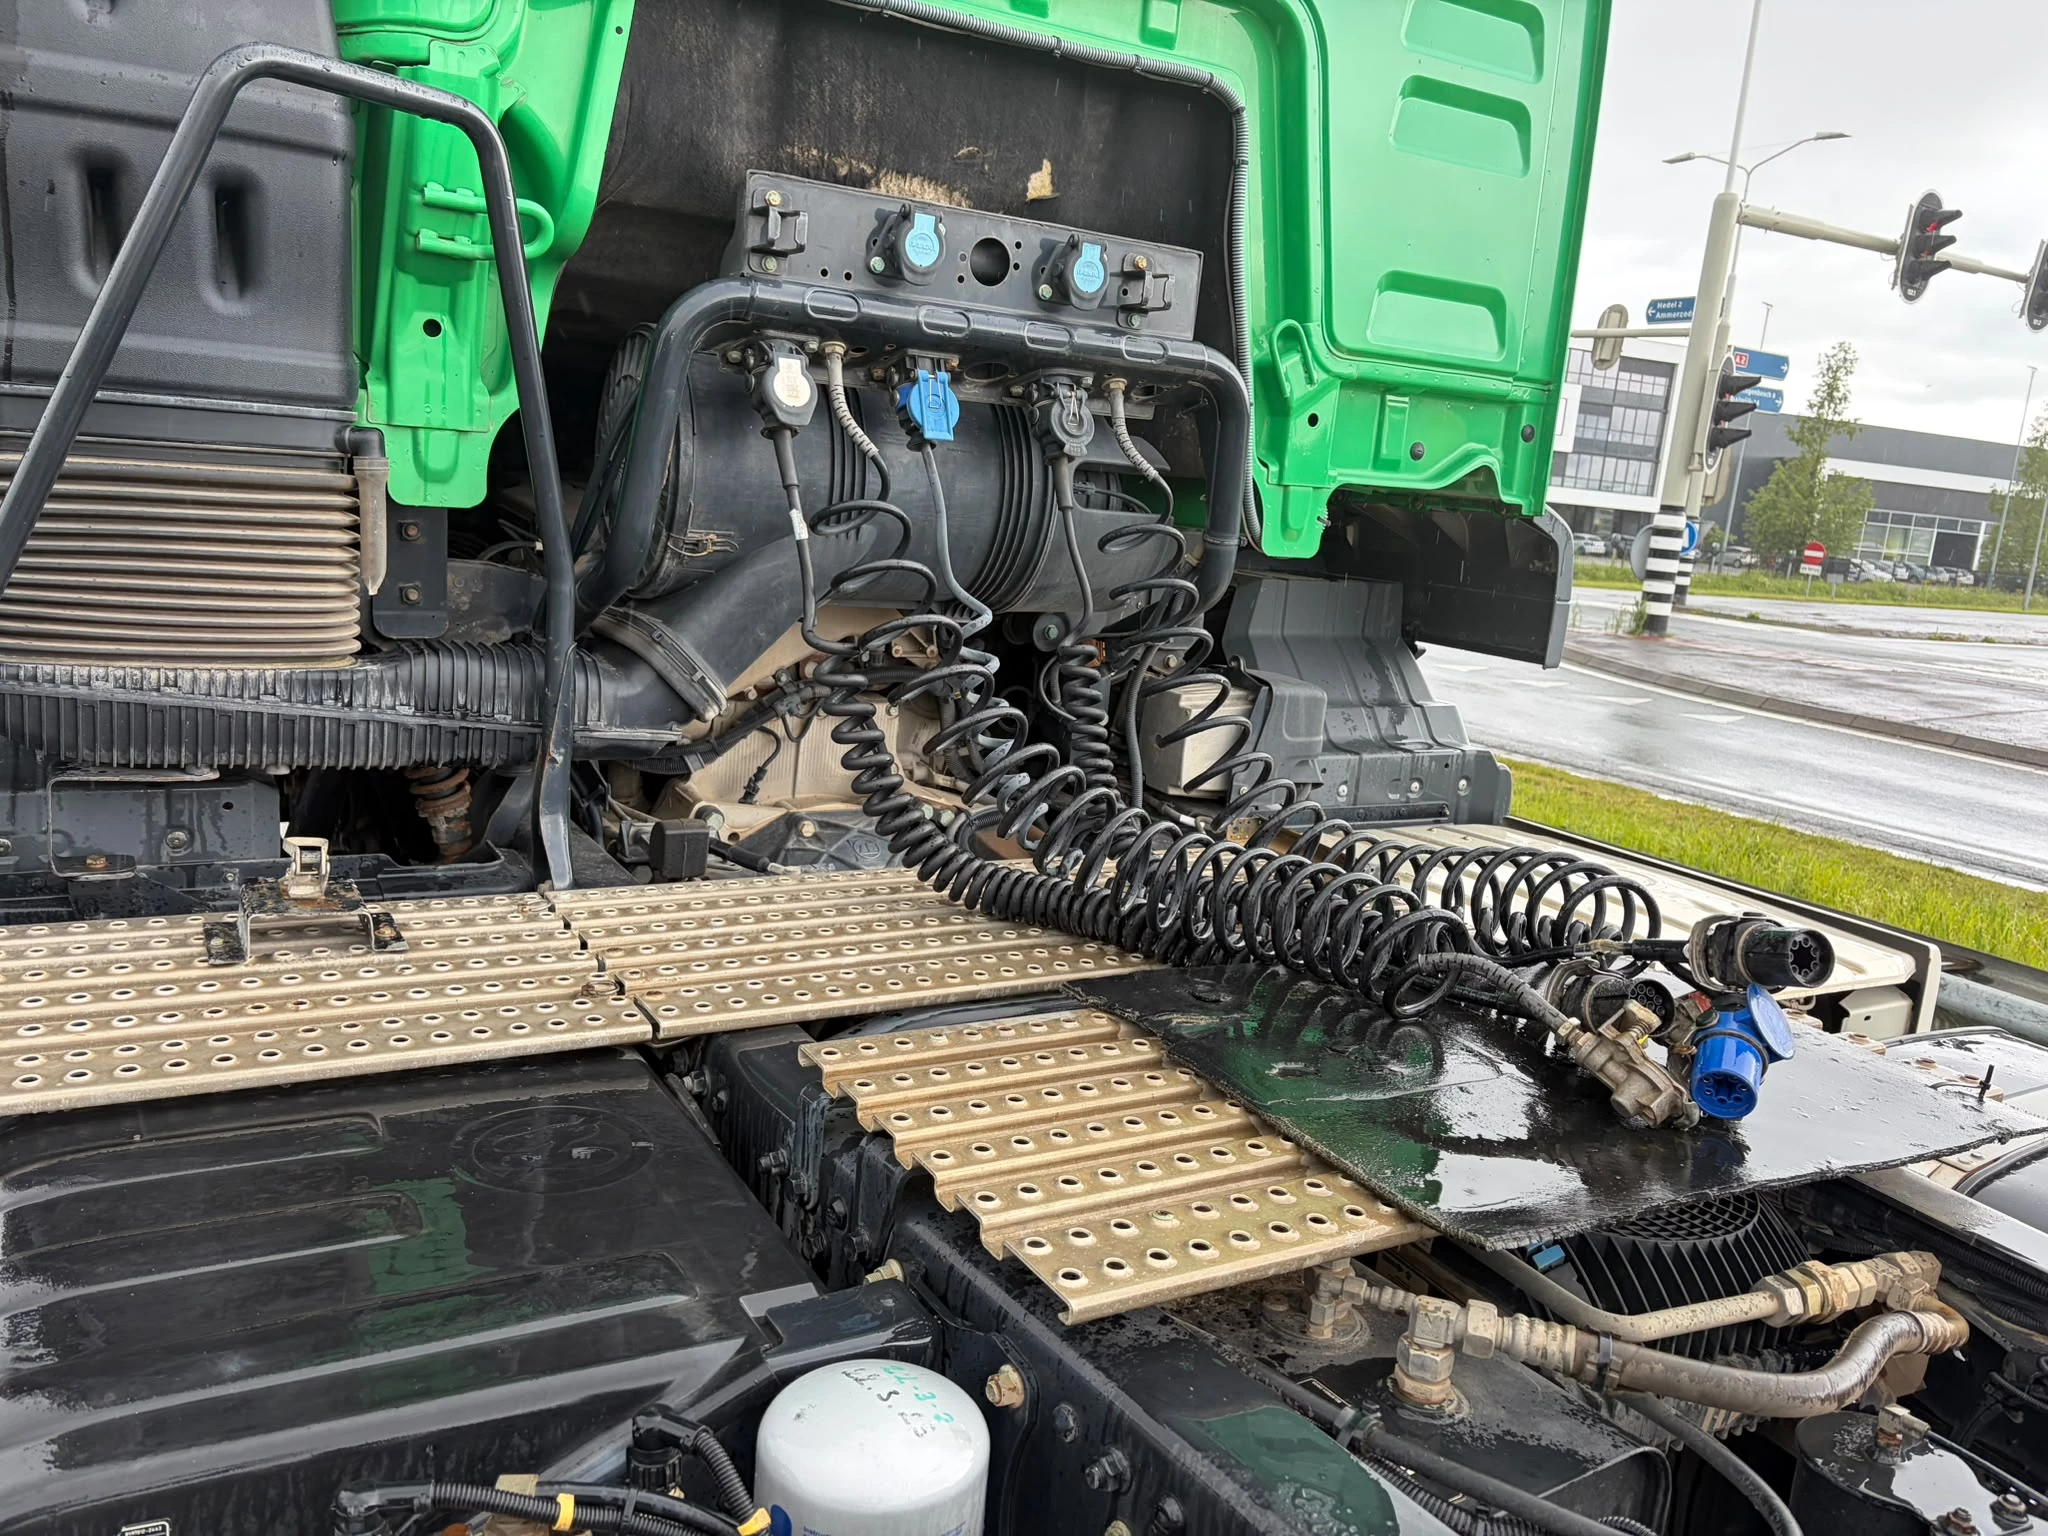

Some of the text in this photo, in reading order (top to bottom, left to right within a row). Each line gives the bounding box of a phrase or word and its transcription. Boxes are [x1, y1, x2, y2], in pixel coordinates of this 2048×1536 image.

[1656, 300, 1678, 309] Hedel
[1655, 310, 1693, 319] Ammerzod
[1735, 354, 1746, 365] A2
